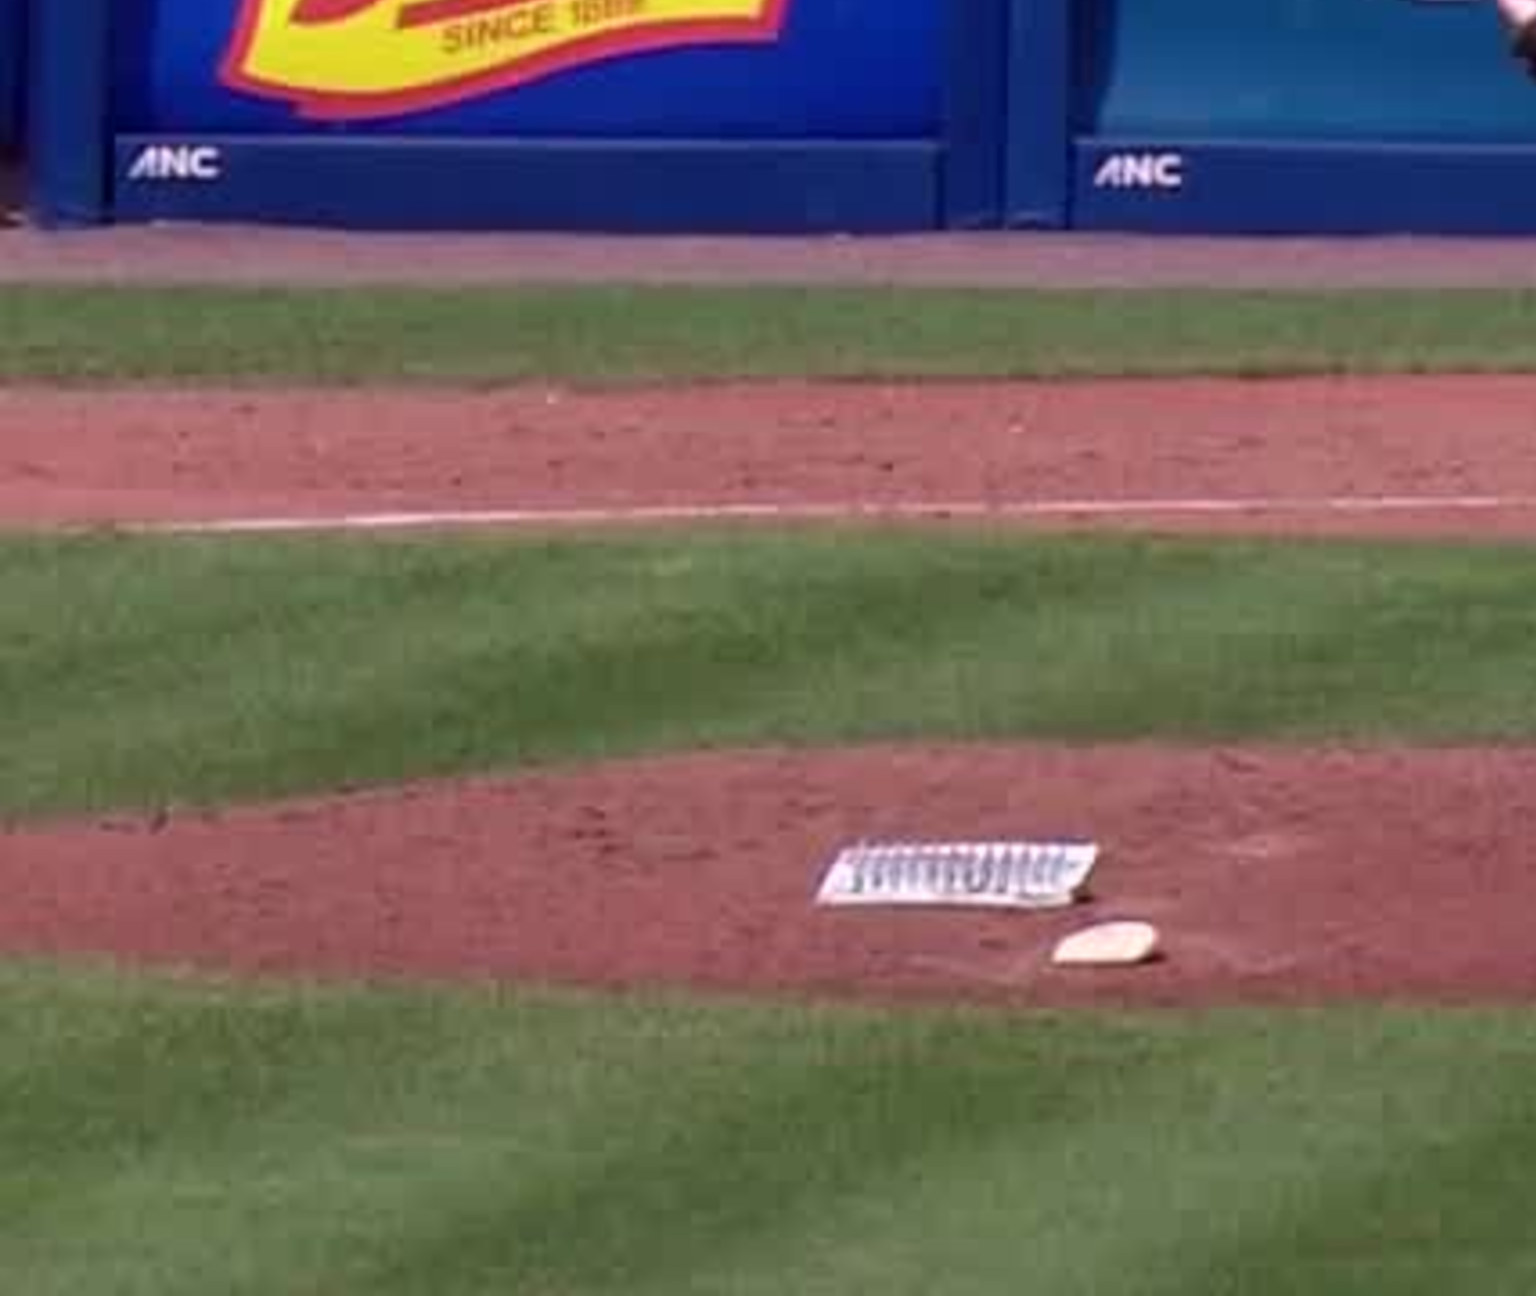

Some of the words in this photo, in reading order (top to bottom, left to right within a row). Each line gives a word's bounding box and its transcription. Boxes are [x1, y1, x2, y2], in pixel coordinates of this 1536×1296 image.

[440, 2, 552, 54] SINCE
[128, 146, 220, 179] ANC
[1093, 153, 1183, 187] ANC
